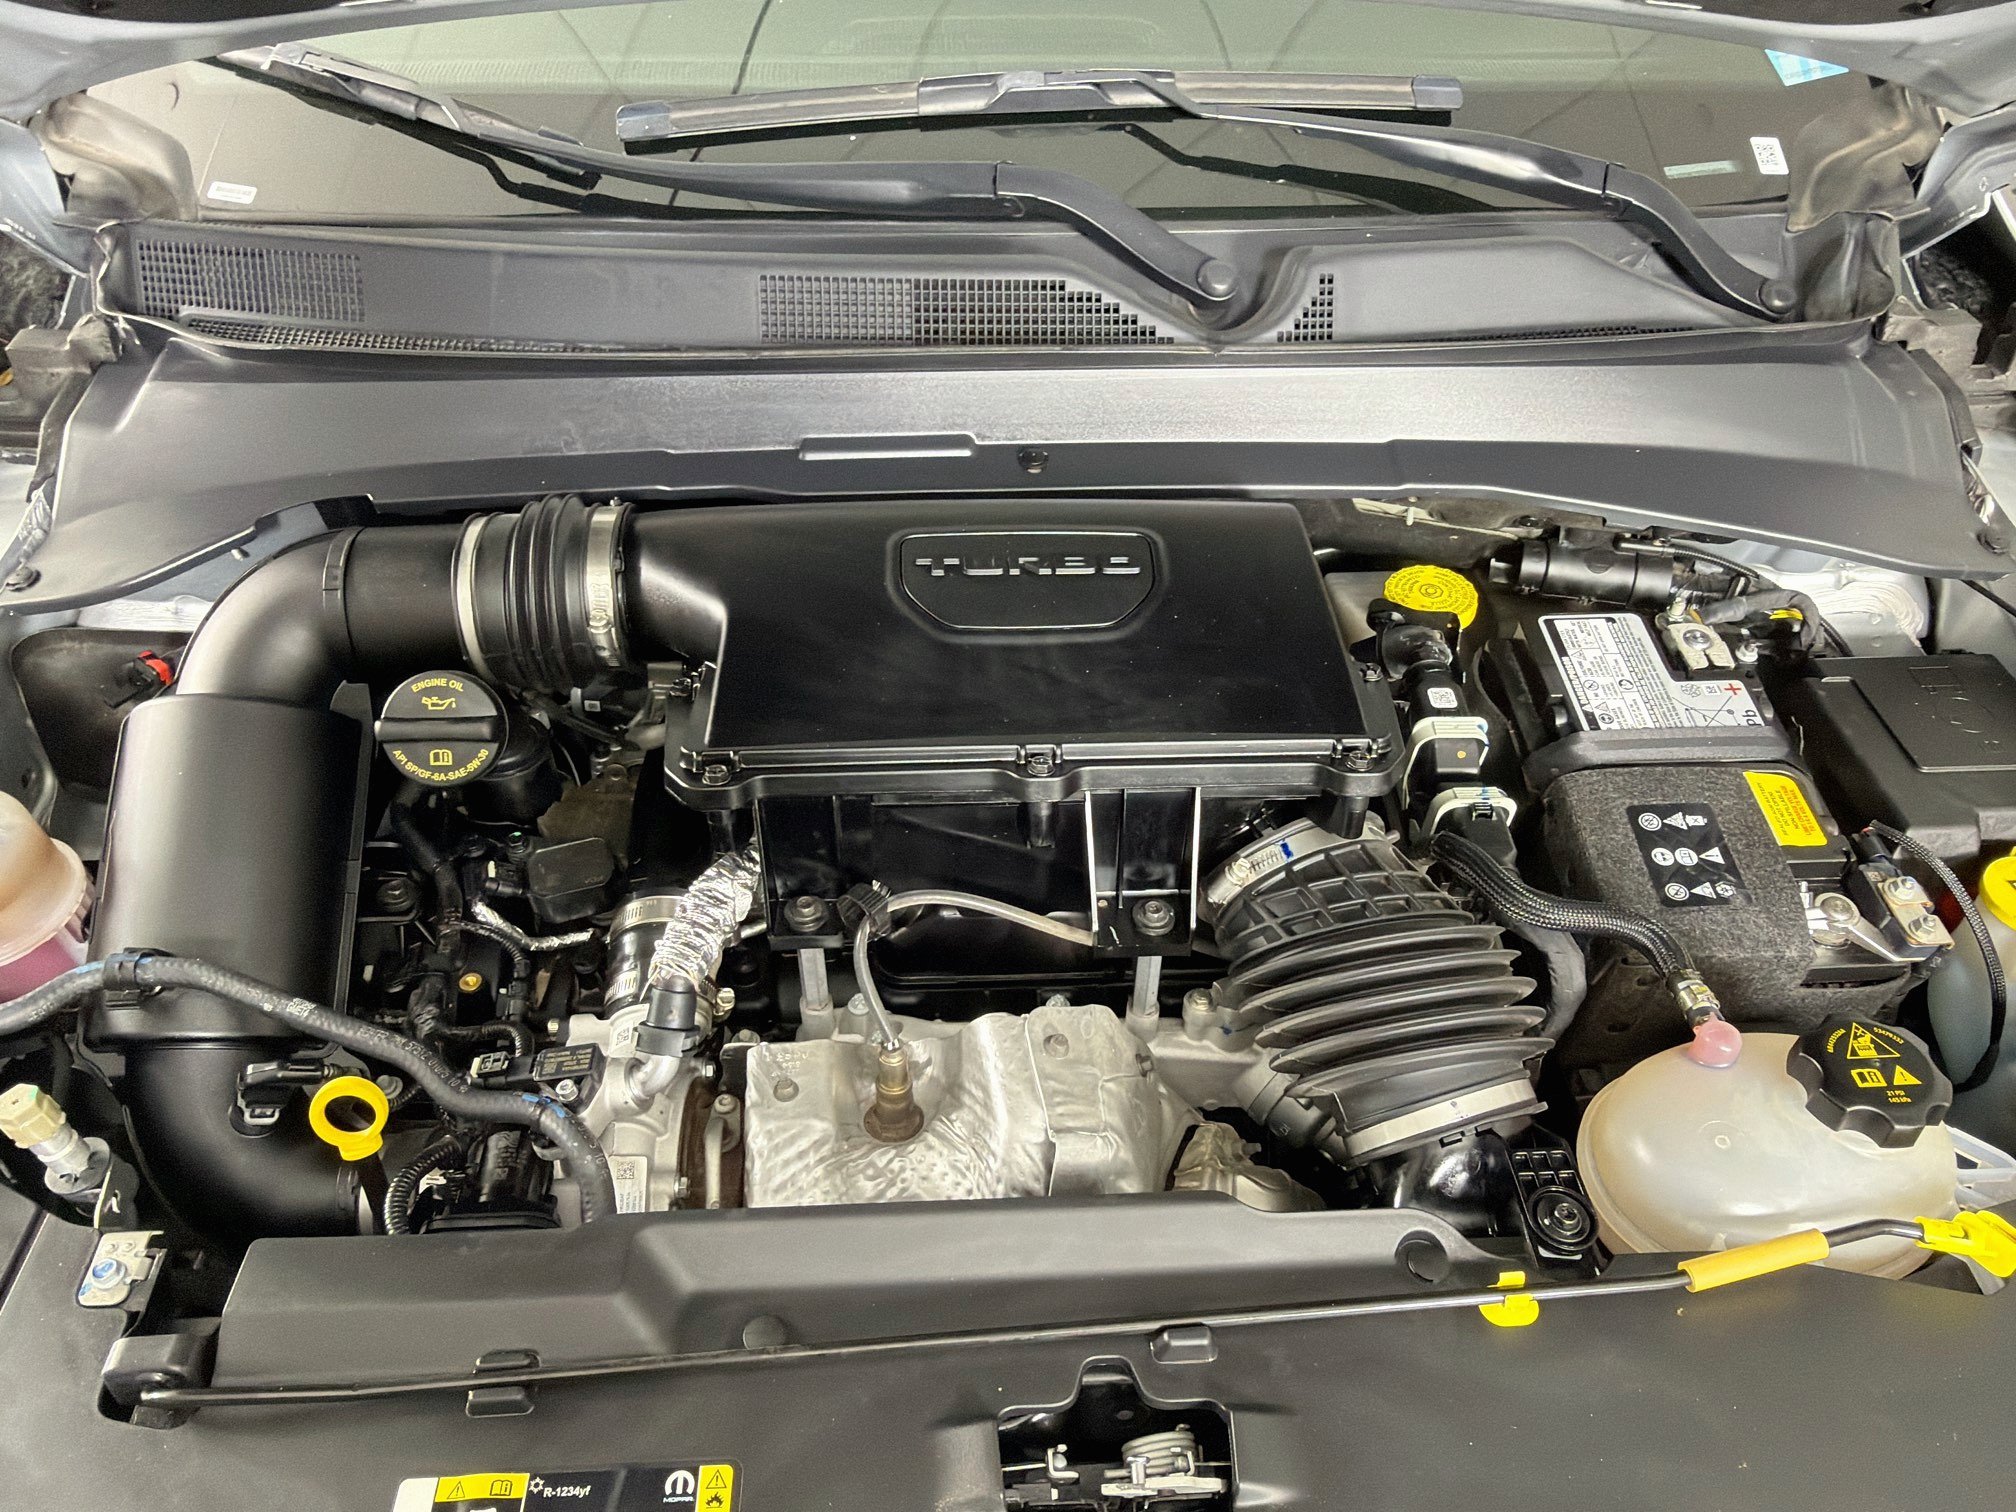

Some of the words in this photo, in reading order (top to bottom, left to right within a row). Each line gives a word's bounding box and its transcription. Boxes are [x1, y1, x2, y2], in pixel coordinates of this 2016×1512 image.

[915, 556, 1141, 578] TURBO
[411, 678, 447, 693] ENGINE
[448, 680, 464, 692] OIL
[392, 749, 408, 765] API
[543, 1484, 592, 1499] R-1234yf
